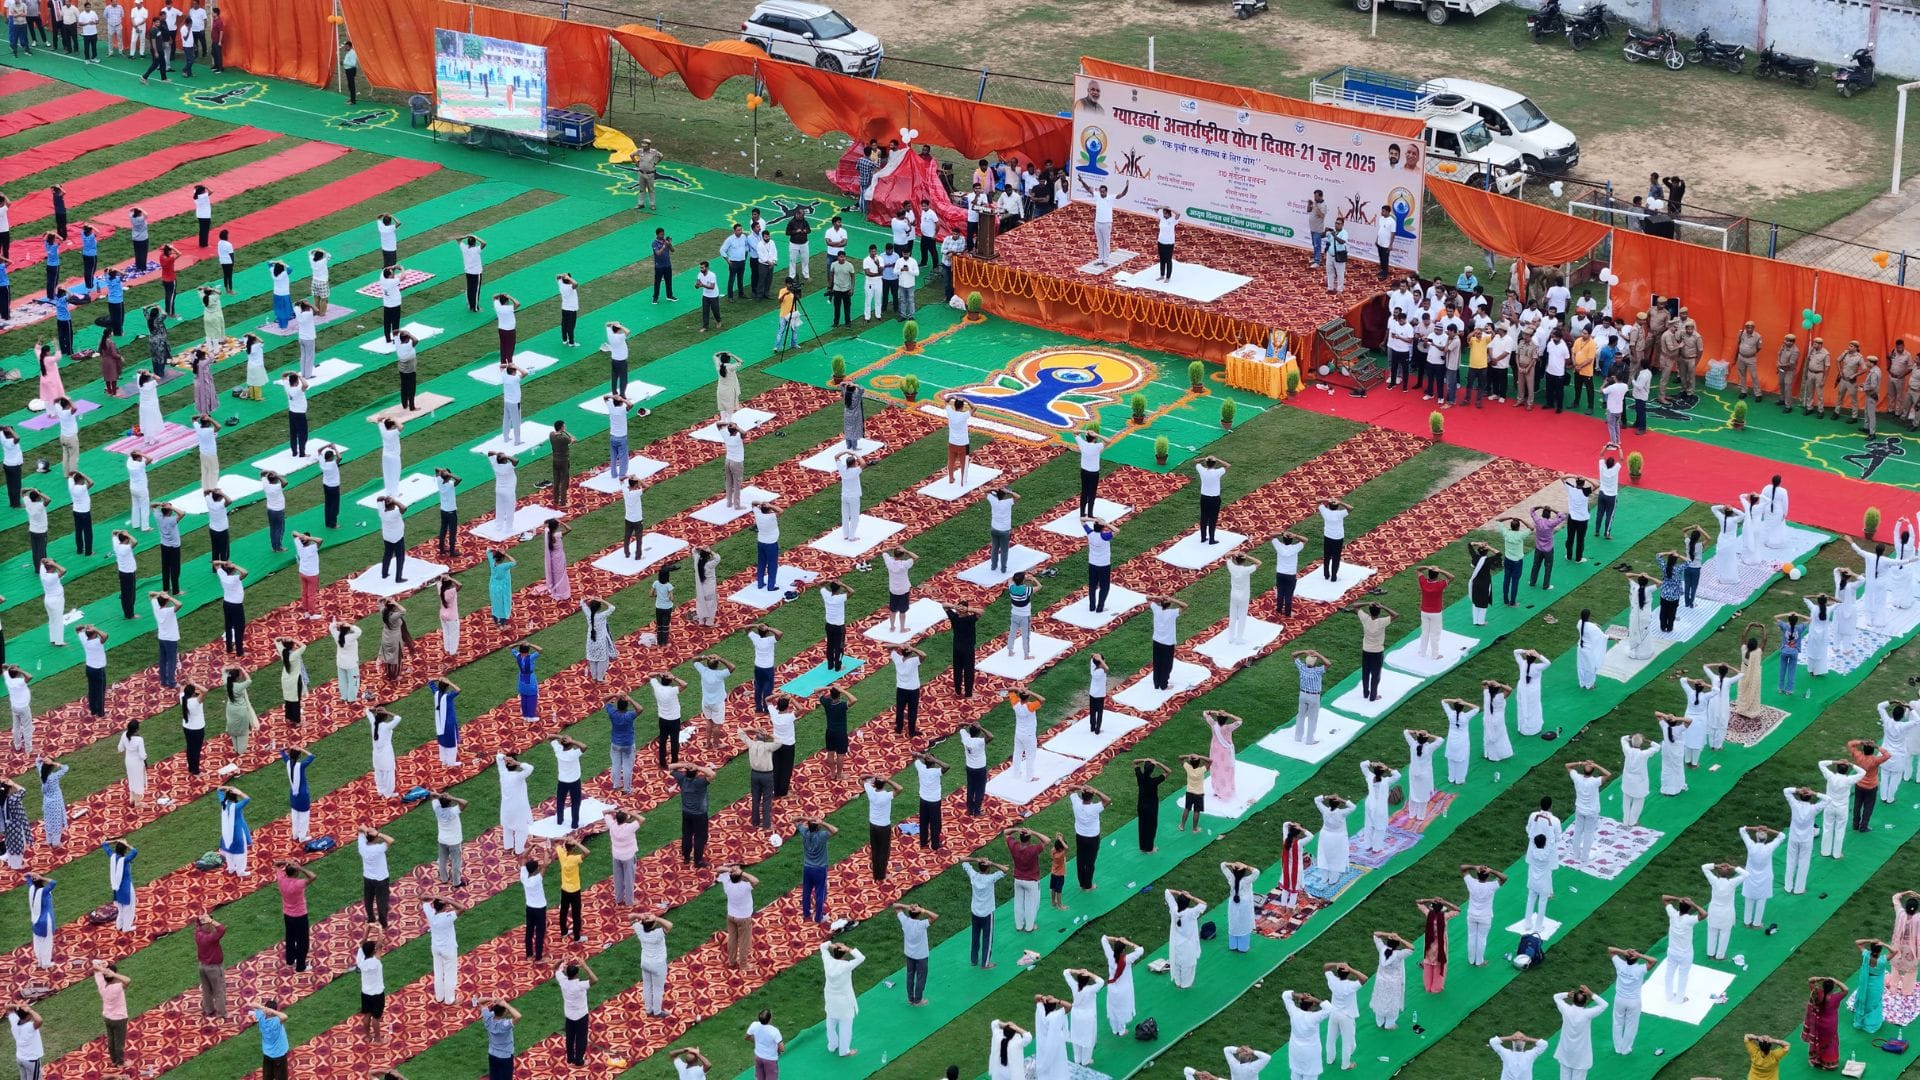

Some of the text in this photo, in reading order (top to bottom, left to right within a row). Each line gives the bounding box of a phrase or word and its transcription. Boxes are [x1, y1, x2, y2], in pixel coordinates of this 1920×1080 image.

[1112, 106, 1161, 131] ग्यारहवां
[1164, 117, 1230, 145] अन्तर्राष्ट्रीय
[1231, 128, 1258, 150] योग
[1317, 147, 1342, 171] जून
[1345, 152, 1376, 173] 2025
